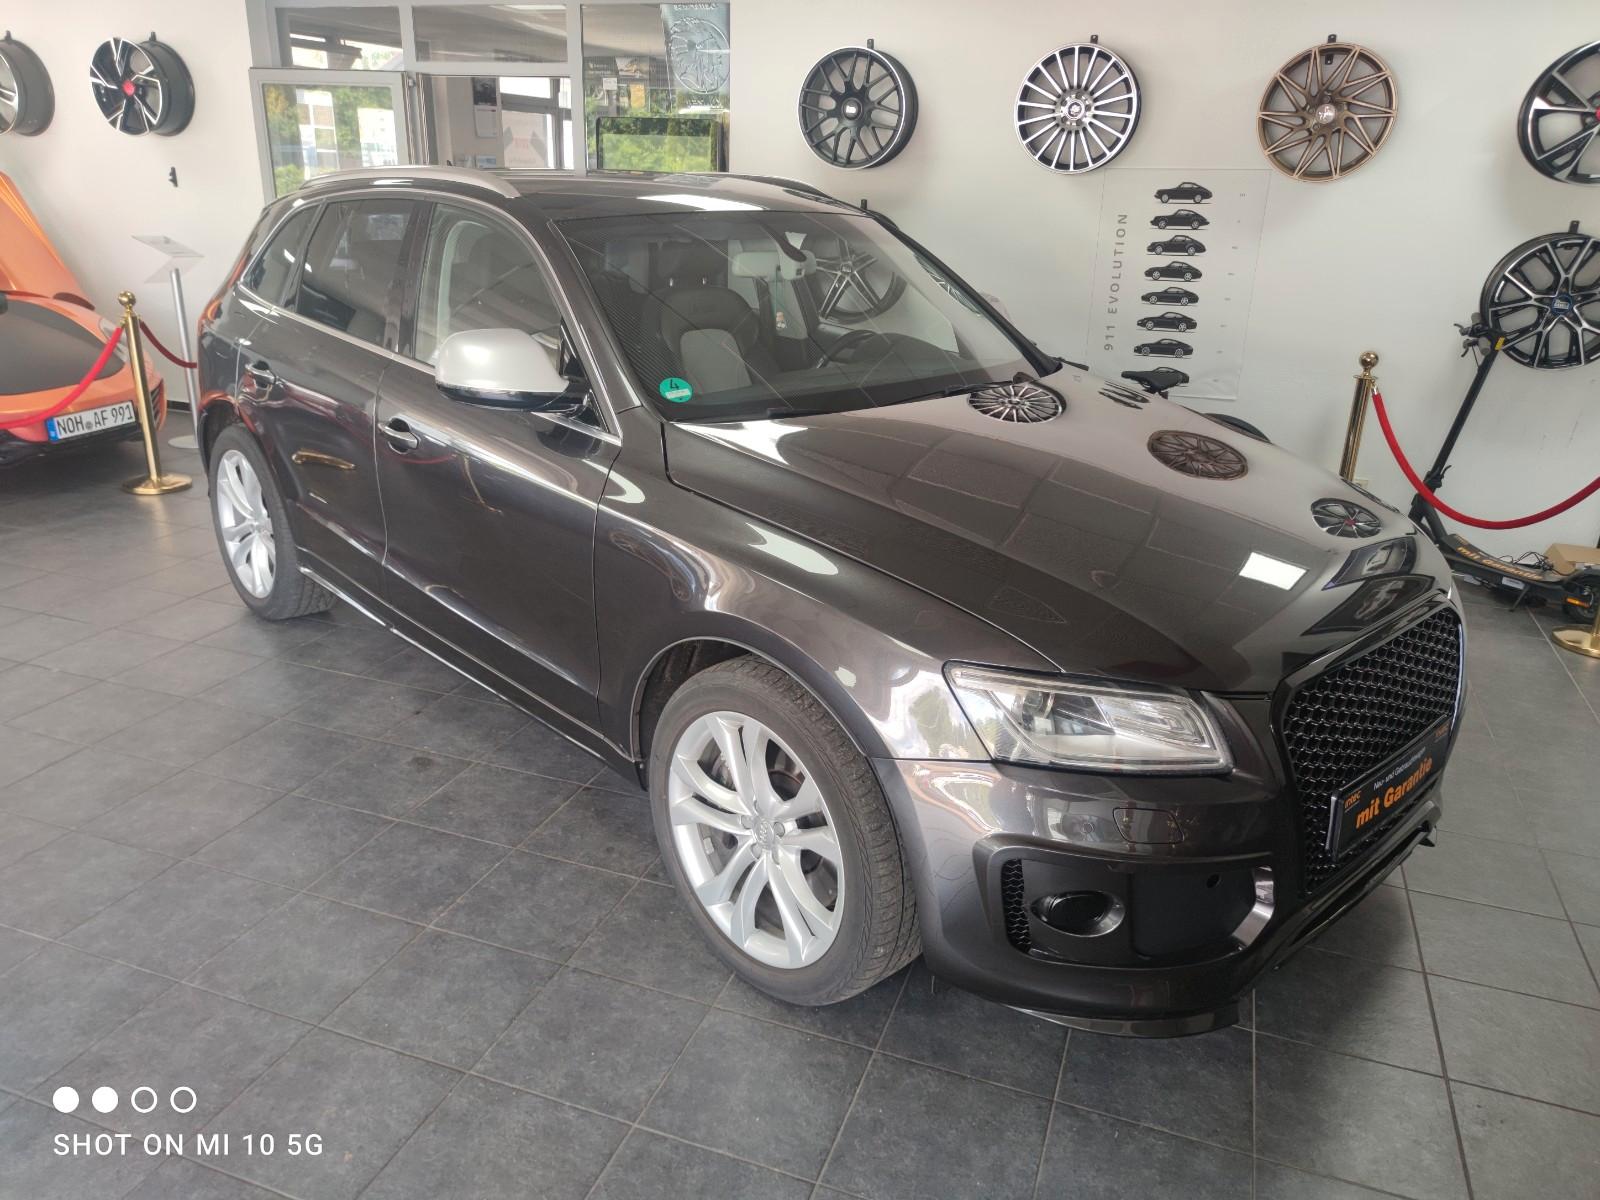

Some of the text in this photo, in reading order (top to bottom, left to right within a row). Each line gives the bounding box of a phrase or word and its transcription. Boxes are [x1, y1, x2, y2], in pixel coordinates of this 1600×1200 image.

[1103, 214, 1128, 351] 911 EVOLUTION
[670, 379, 680, 389] 4
[57, 404, 133, 435] NOH AF 991
[1355, 757, 1433, 830] mit Garantie
